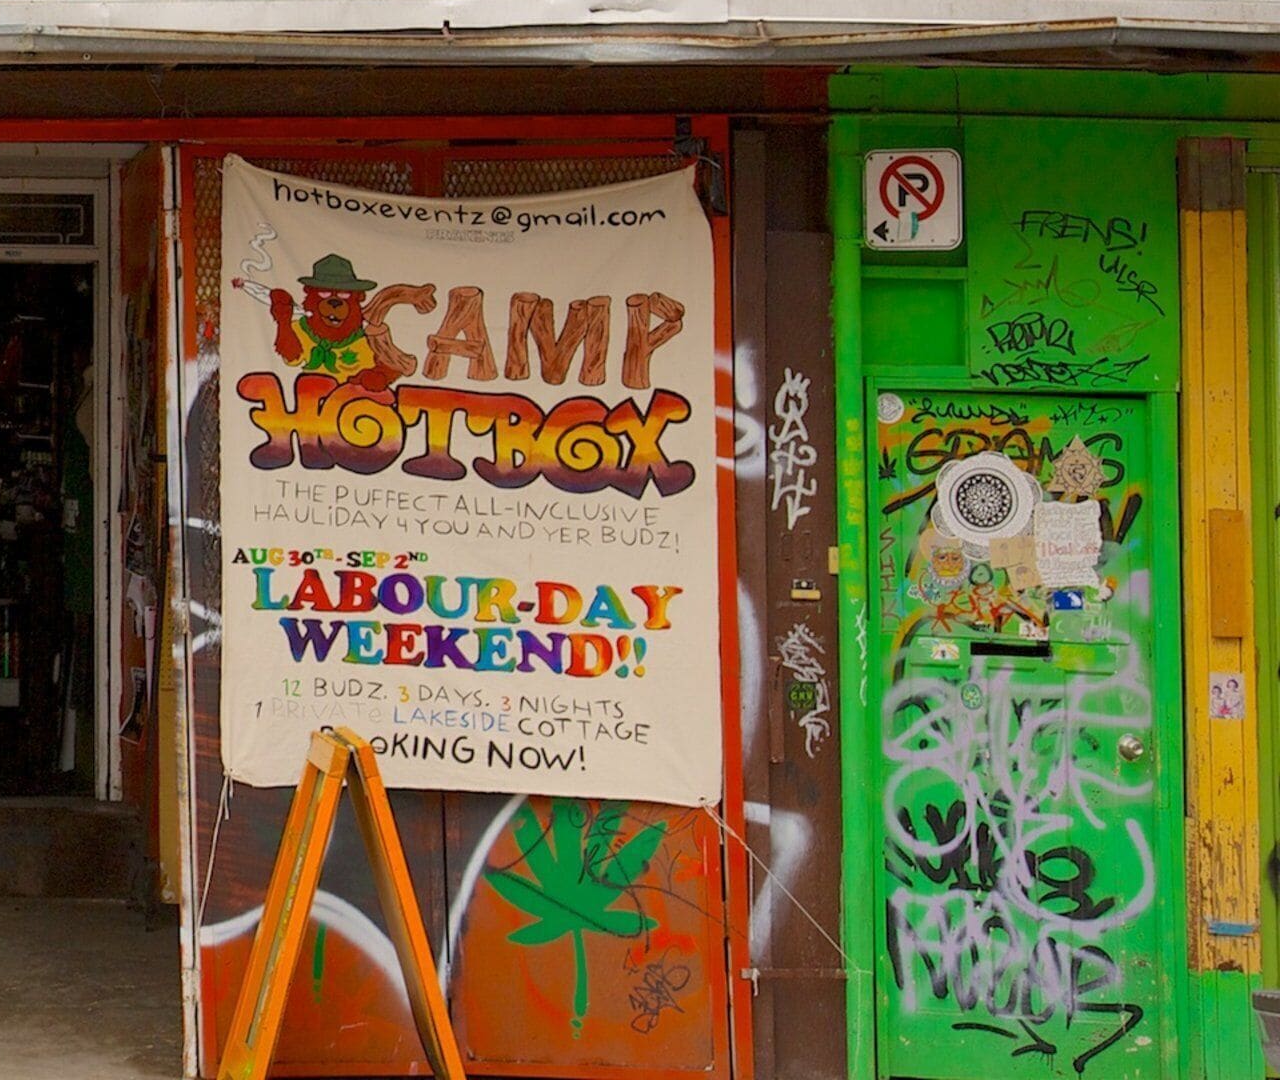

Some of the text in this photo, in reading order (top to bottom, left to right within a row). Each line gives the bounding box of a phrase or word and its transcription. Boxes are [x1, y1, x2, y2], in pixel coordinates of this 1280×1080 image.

[273, 178, 666, 233] hotboxeventz@gmail.com
[361, 283, 685, 390] CAMP
[236, 371, 697, 500] HOTBOX
[276, 479, 660, 525] THE PUFFECT ALL-INCLUSIVE
[232, 547, 285, 567] AUG
[346, 551, 392, 569] SEP
[393, 549, 429, 569] 2ND
[542, 525, 592, 546] YER
[601, 526, 682, 555] BUDZ!
[251, 566, 684, 630] LABOUR-DAY
[278, 617, 648, 679] WEEKEND!!
[282, 678, 302, 698] 12
[398, 685, 410, 703] 3
[500, 695, 513, 712] 3
[519, 695, 625, 719] NIGHTS
[393, 705, 509, 734] LAKESIDE
[517, 717, 651, 745] COTTAGE
[487, 742, 588, 772] NOW!
